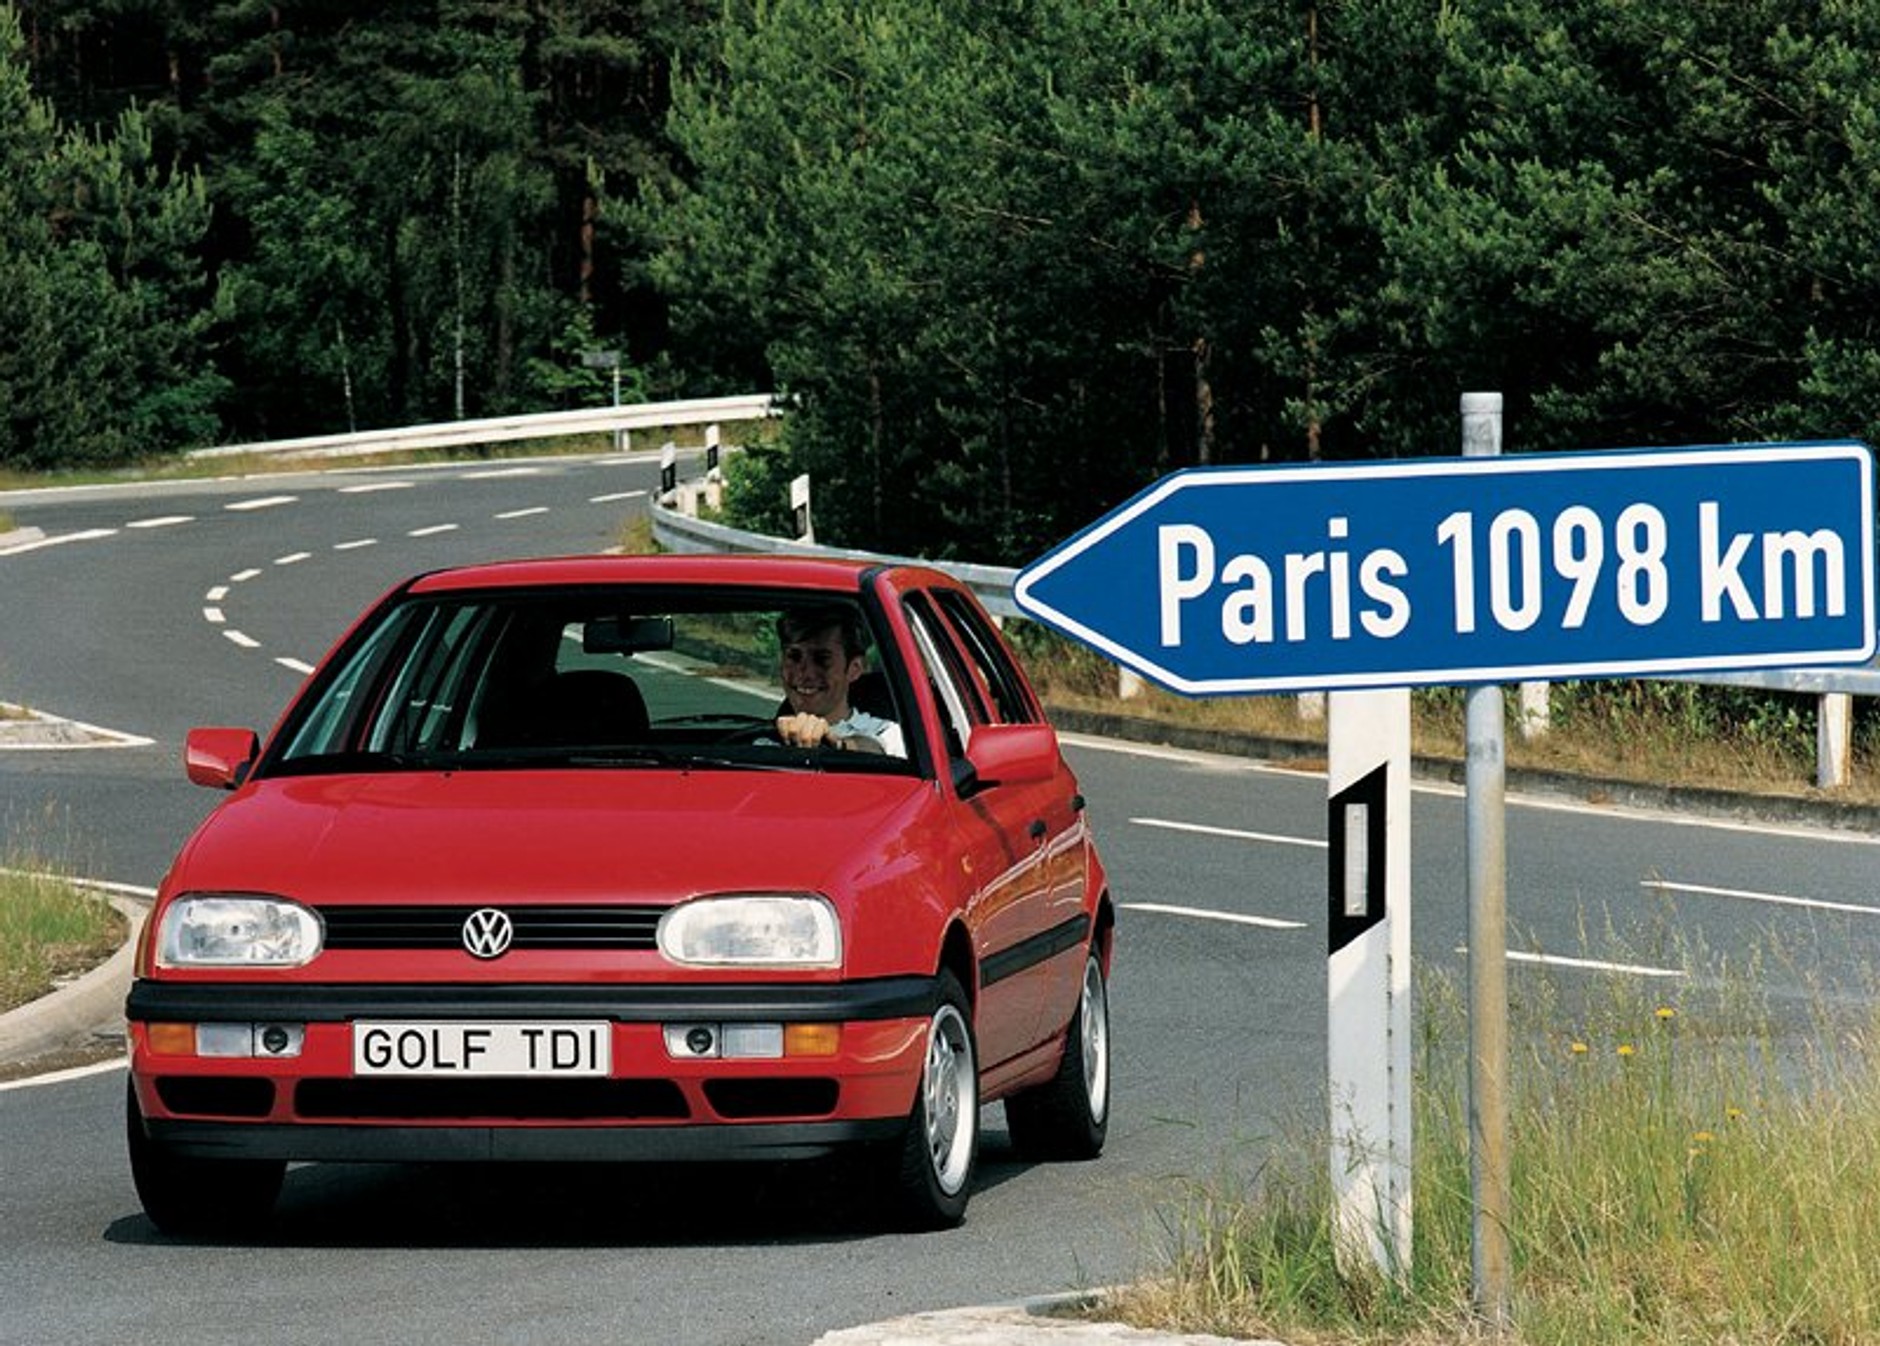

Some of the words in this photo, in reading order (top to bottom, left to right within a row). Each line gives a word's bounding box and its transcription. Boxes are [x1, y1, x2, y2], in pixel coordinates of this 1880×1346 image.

[1158, 517, 1411, 647] Paris
[1437, 502, 1669, 633] 1098
[1699, 501, 1846, 622] km
[463, 908, 513, 957] VW
[363, 1029, 492, 1070] GOLF
[521, 1029, 597, 1070] TDI
